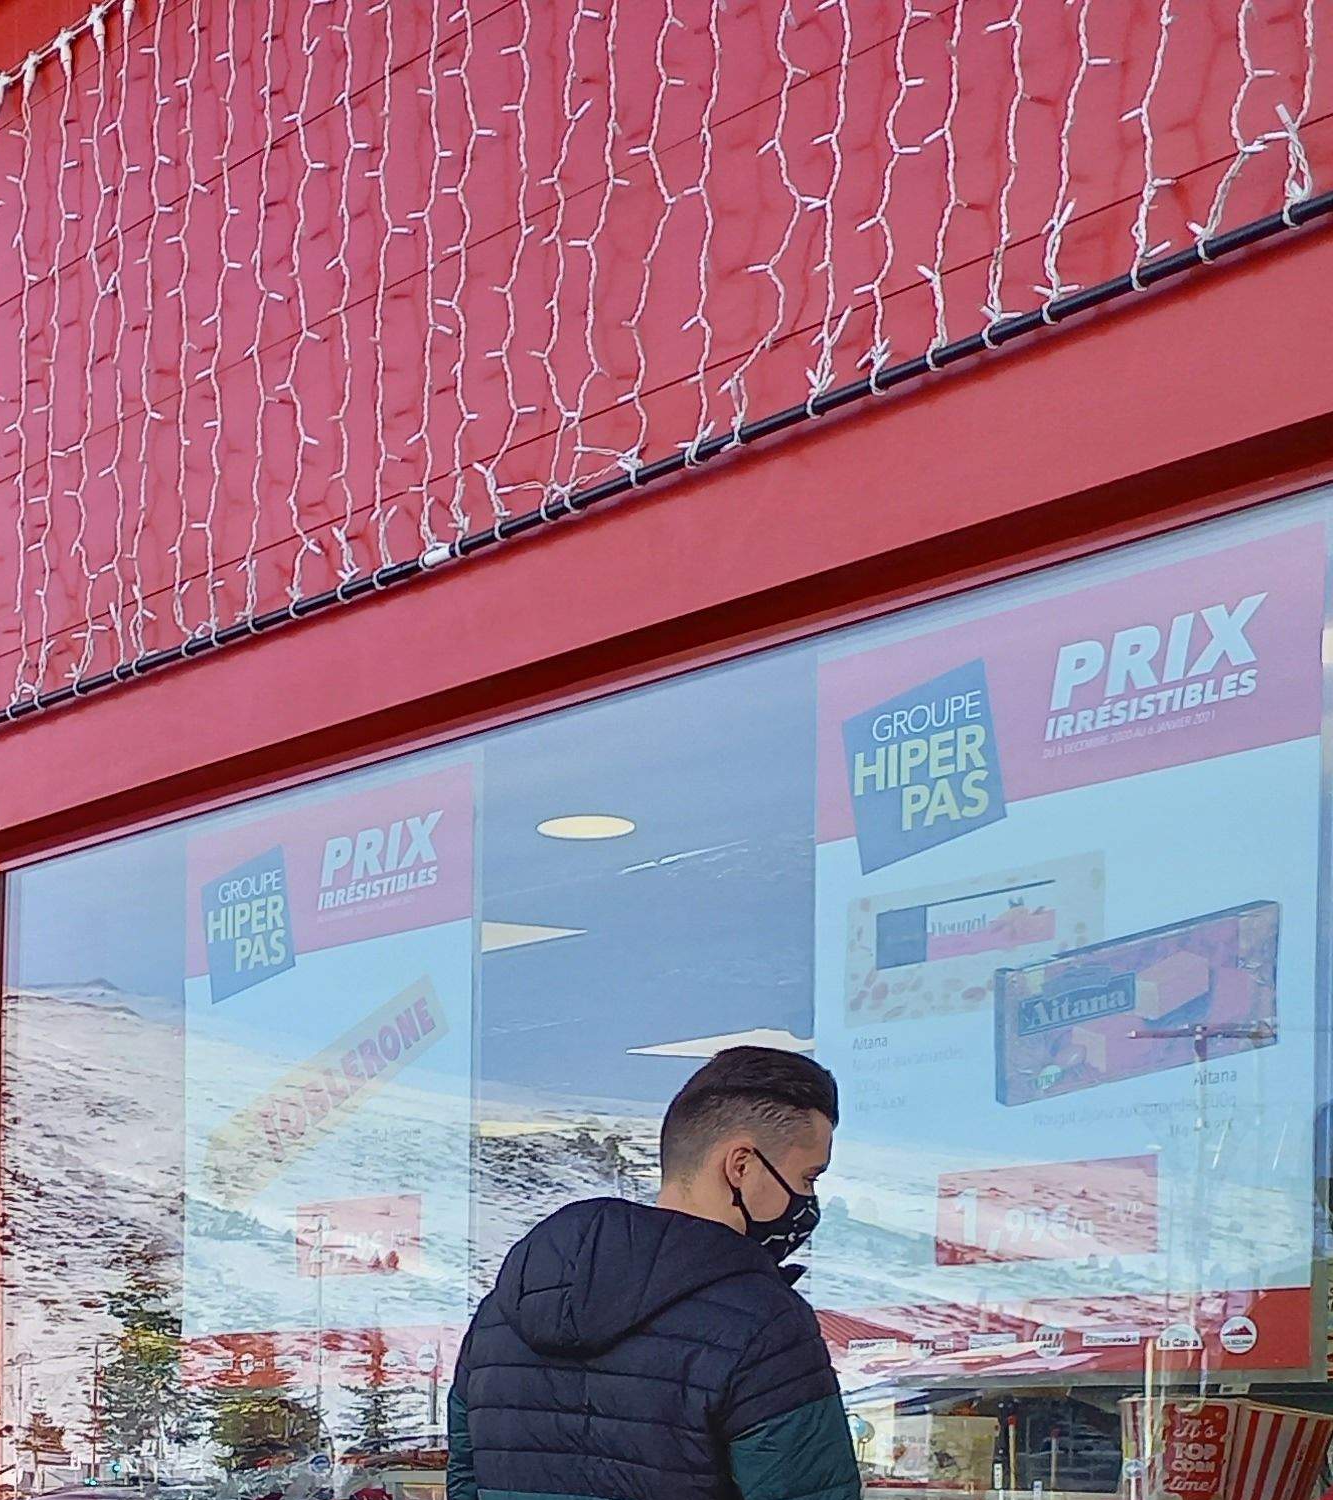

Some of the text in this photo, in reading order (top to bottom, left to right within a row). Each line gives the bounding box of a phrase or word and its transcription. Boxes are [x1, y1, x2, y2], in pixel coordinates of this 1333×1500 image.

[1050, 592, 1268, 711] PRIX
[872, 690, 981, 743] GROUPE
[1044, 669, 1258, 742] IRRÉSISTIBLES
[853, 724, 986, 797] HIPER
[901, 769, 989, 832] PAS
[319, 810, 443, 888] PRIX
[218, 868, 282, 903] GROUPE
[317, 866, 437, 911] IRRÉSISTIBLES
[207, 895, 284, 944] HIPER
[235, 929, 286, 972] PAS
[1032, 987, 1130, 1026] Aitana
[852, 1035, 888, 1050] Aitana
[257, 998, 436, 1164] TOBLERONE
[1194, 1069, 1238, 1087] Aitana
[1172, 1441, 1217, 1461] TOP
